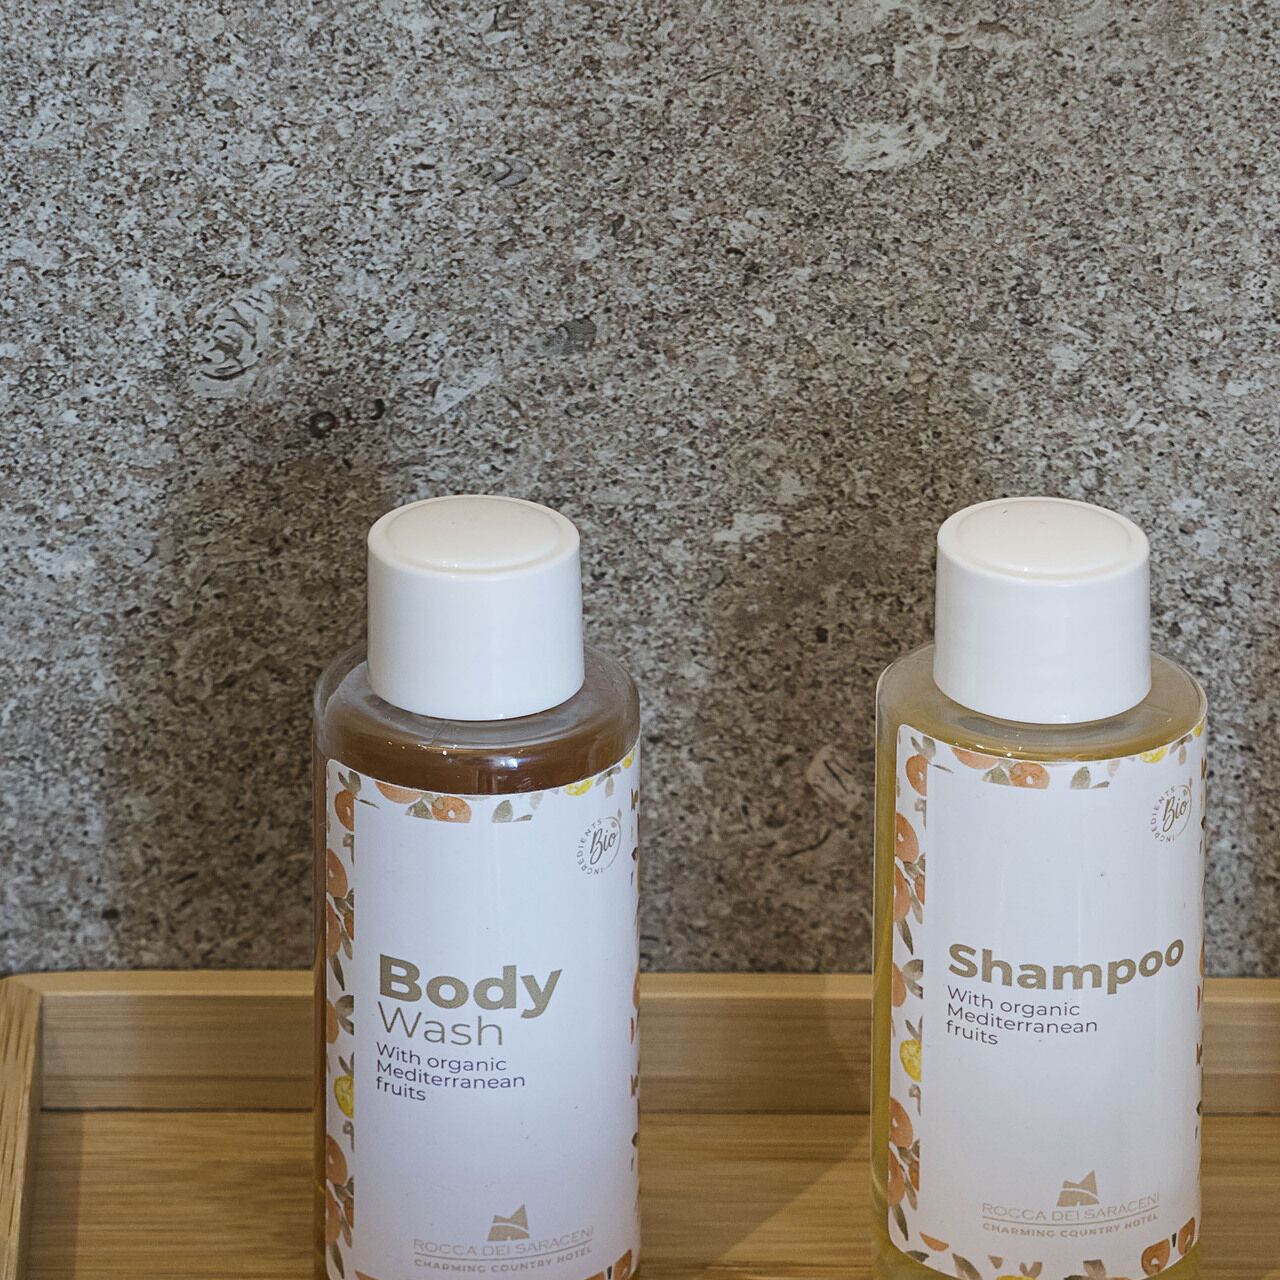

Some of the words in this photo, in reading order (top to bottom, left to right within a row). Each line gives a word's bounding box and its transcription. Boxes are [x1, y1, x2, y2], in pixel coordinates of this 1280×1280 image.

[1162, 796, 1189, 832] Bio
[589, 828, 617, 865] Bio
[948, 939, 1185, 995] Shampoo
[379, 953, 563, 1019] Body
[947, 984, 993, 1010] With
[1000, 1001, 1080, 1018] organic
[377, 1000, 503, 1046] Wash
[946, 1020, 998, 1046] fruits
[947, 1003, 1098, 1034] Mediterranean
[376, 1041, 421, 1065] With
[427, 1055, 507, 1074] organic
[376, 1059, 526, 1089] Mediterranean
[376, 1076, 427, 1101] fruits
[982, 1202, 1047, 1221] ROCCA
[1051, 1207, 1080, 1222] DEI
[1084, 1191, 1160, 1219] SARACENI
[413, 1238, 477, 1257] ROCCA
[482, 1243, 510, 1257] DEI
[515, 1225, 595, 1253] SARACENI
[982, 1222, 1055, 1238] CHARMING
[1060, 1222, 1120, 1238] COUNTRY
[1124, 1213, 1158, 1230] HOTEL
[414, 1258, 486, 1273] CHARMING
[491, 1258, 552, 1273] COUNTRY
[556, 1246, 593, 1264] HOTEL
